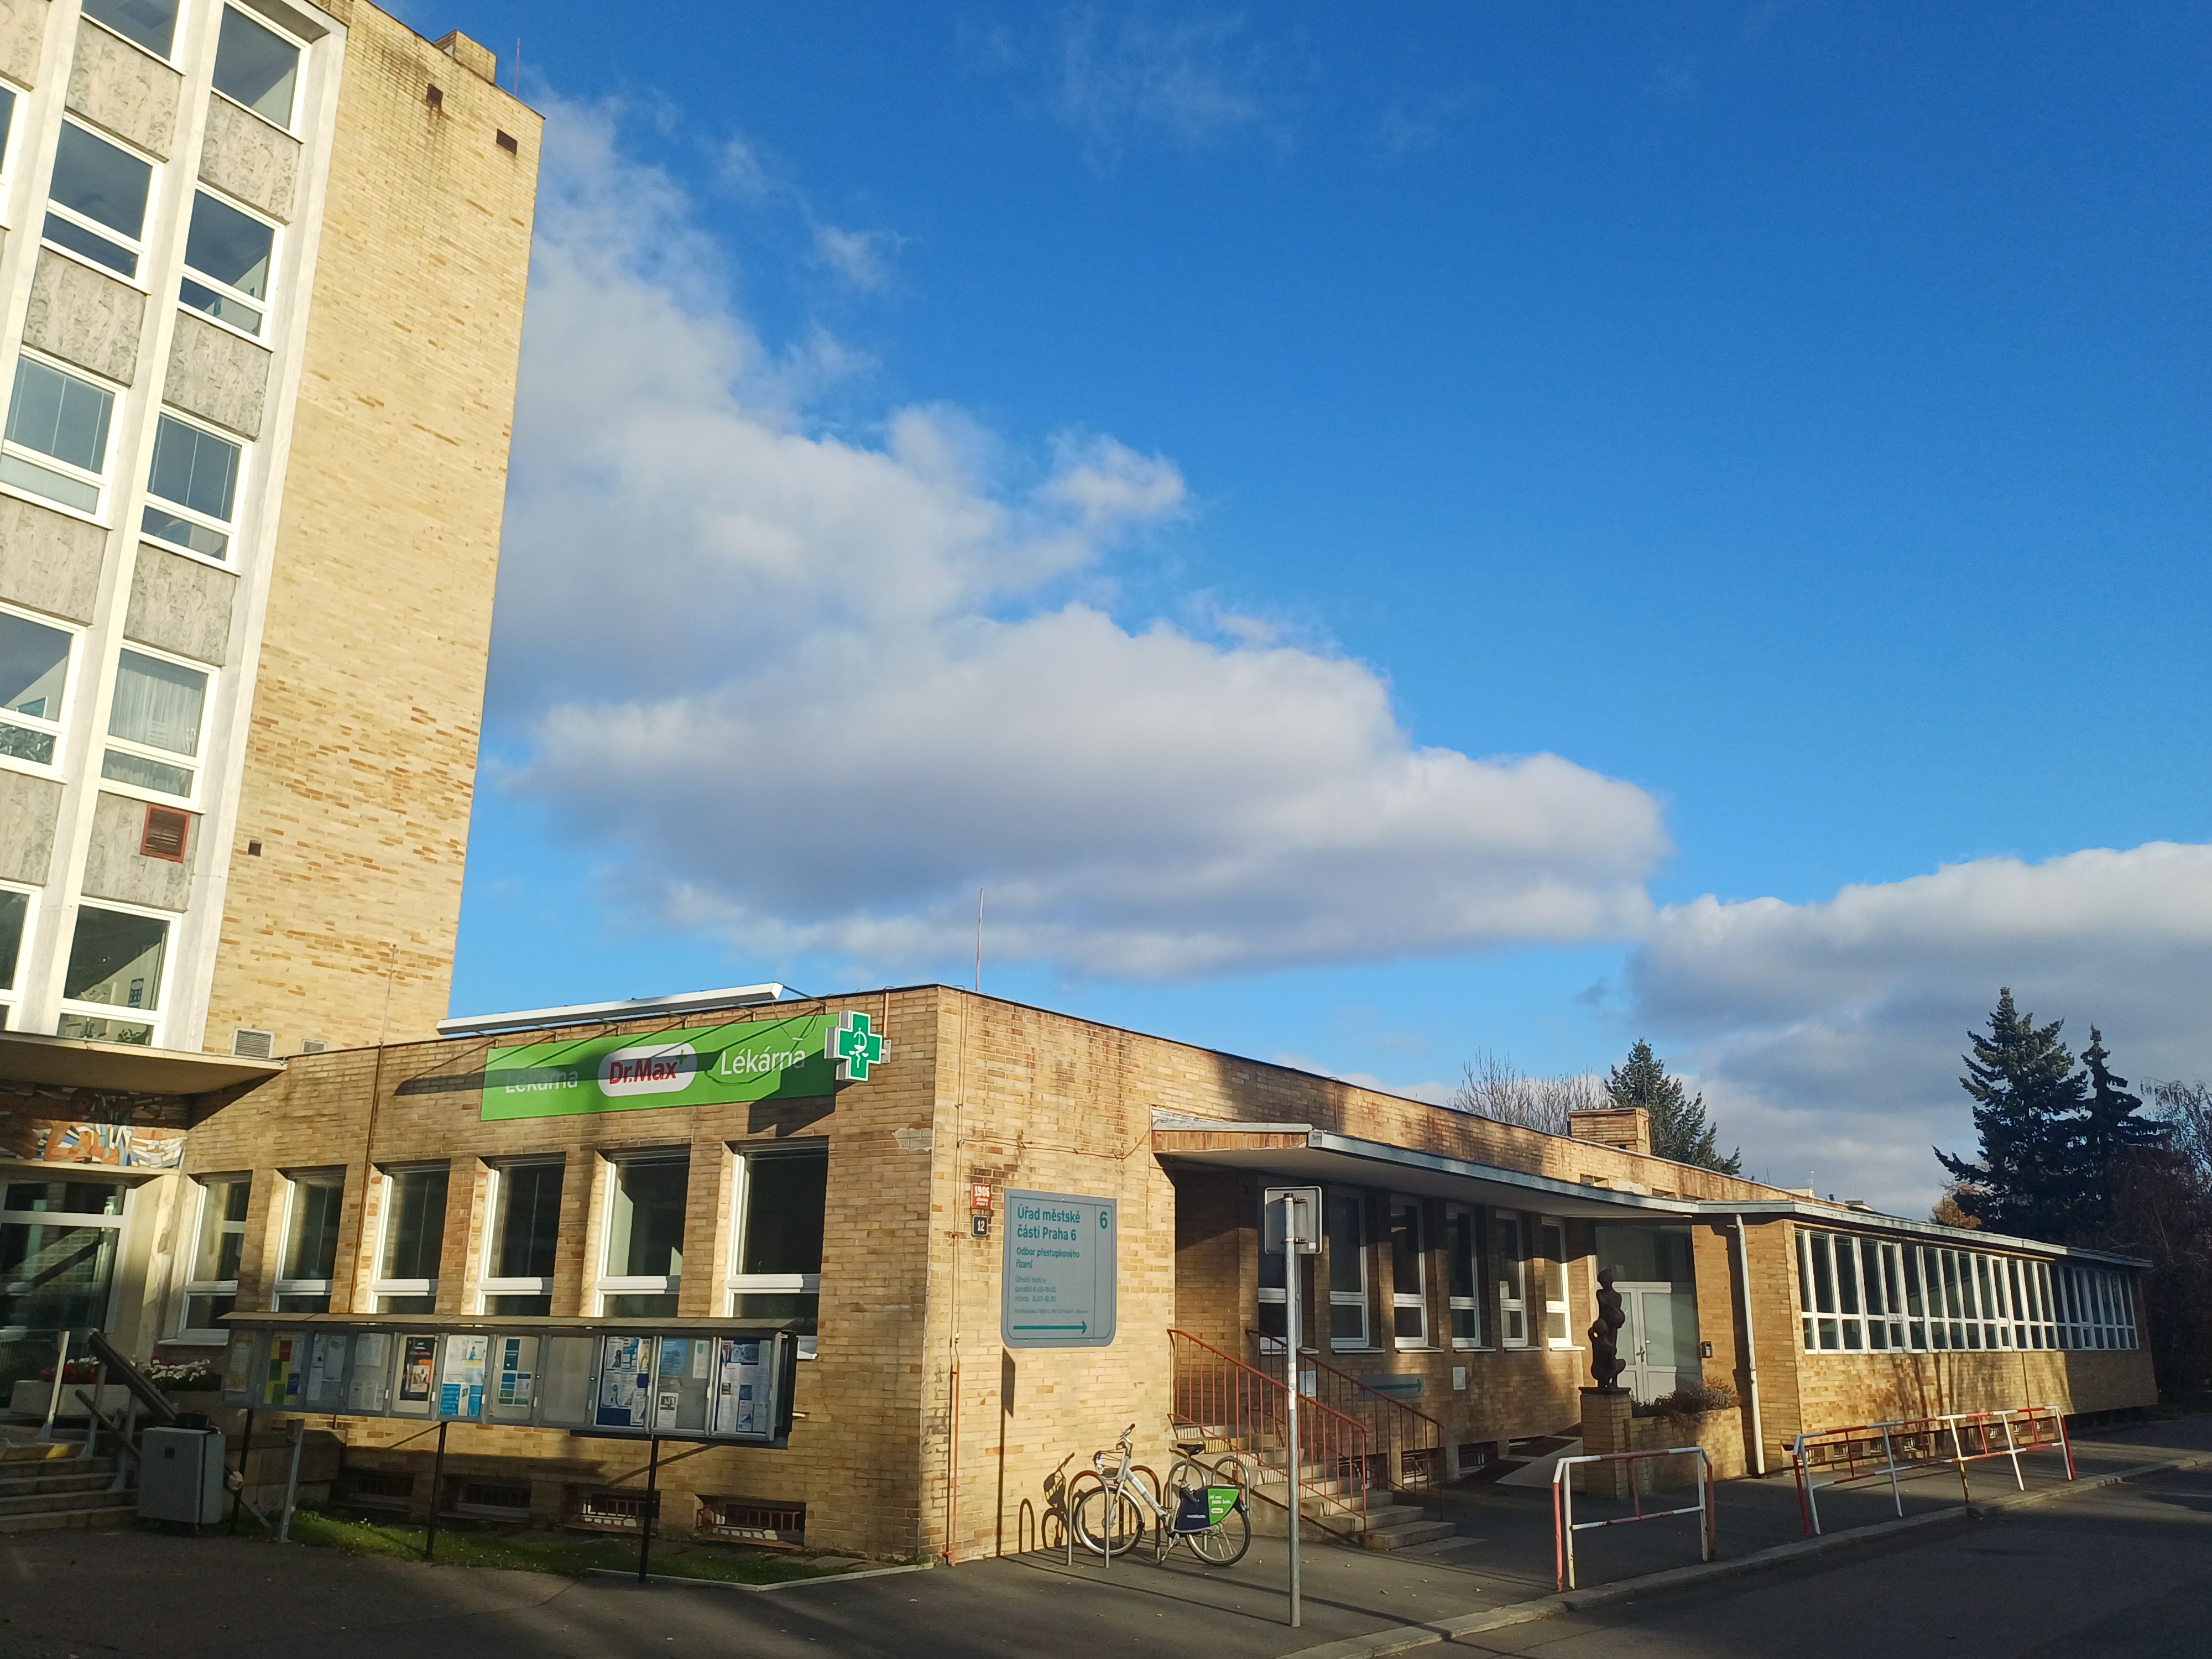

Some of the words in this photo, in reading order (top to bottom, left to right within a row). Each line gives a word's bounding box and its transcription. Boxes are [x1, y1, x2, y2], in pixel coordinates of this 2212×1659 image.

[609, 1058, 677, 1085] Dr.Max
[721, 1046, 806, 1075] Lékárna
[974, 1185, 990, 1198] 1906
[1018, 1203, 1040, 1220] Úřad
[1042, 1208, 1081, 1223] městské
[1099, 1211, 1108, 1229] 6
[977, 1220, 985, 1232] 12
[1017, 1224, 1040, 1239] části
[1042, 1227, 1068, 1240] Praha
[1071, 1229, 1077, 1241] 6
[1016, 1247, 1036, 1256] Odbor
